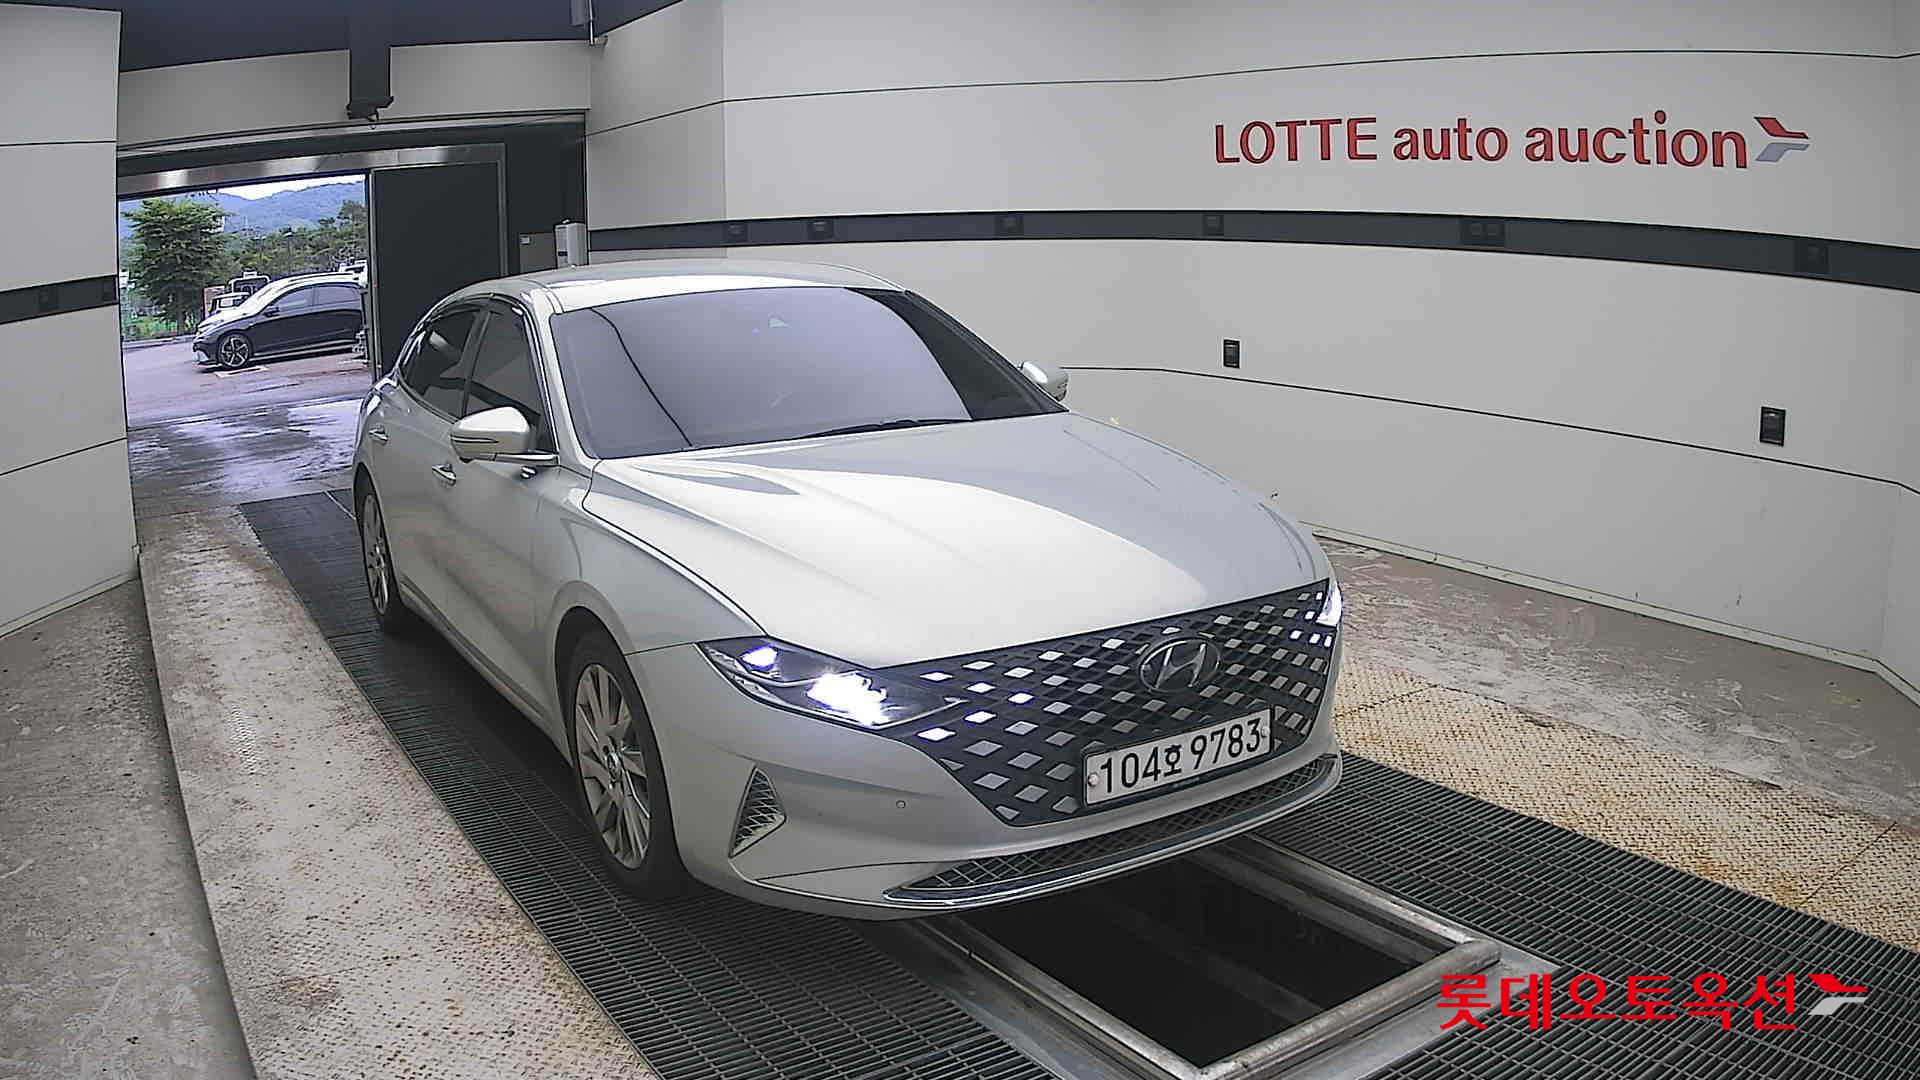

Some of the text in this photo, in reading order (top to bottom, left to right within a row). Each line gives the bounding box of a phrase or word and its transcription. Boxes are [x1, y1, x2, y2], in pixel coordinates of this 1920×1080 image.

[1215, 110, 1749, 169] LOTTE auto auction
[1100, 717, 1261, 793] 104호 9783
